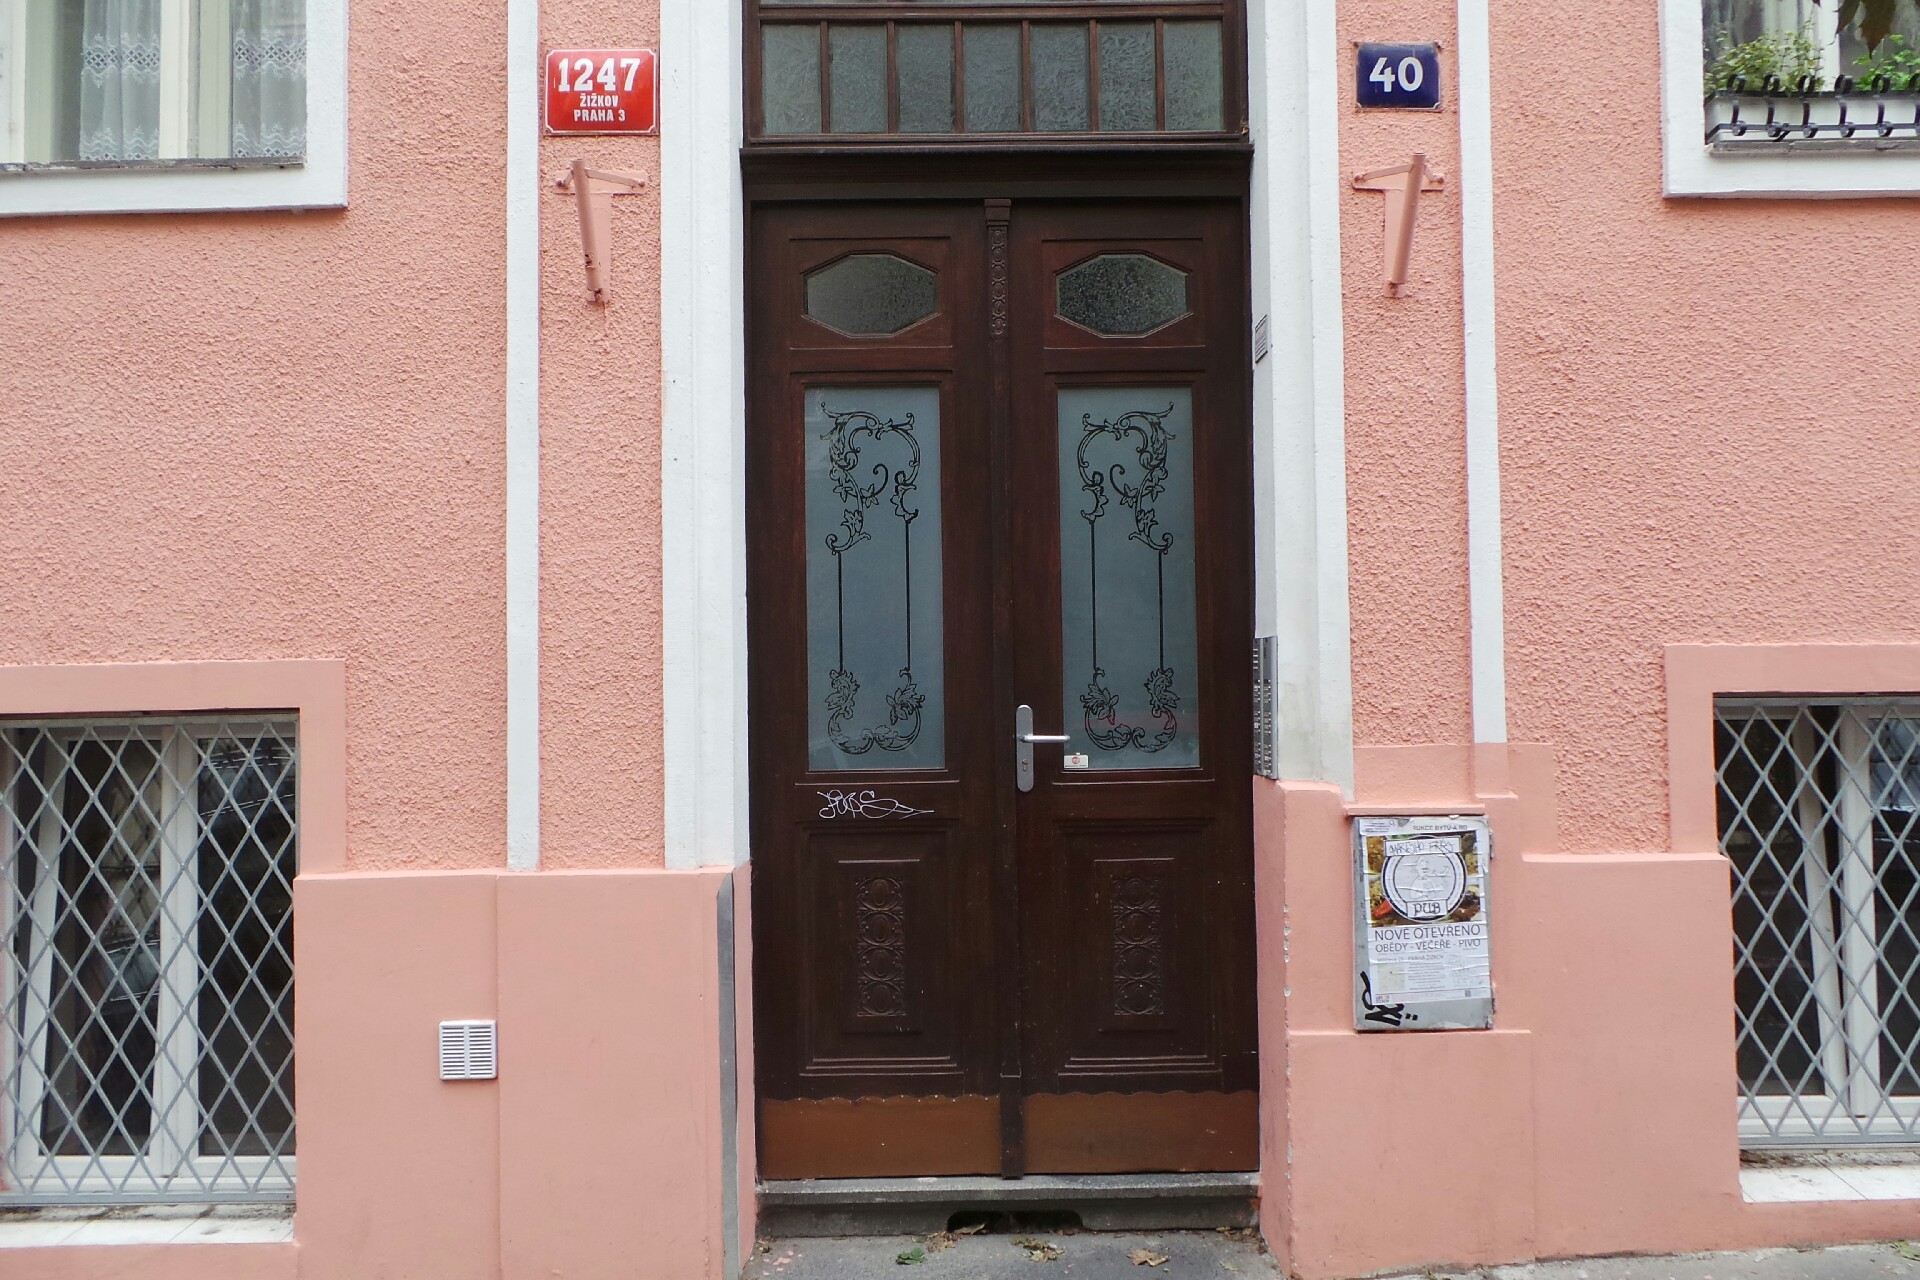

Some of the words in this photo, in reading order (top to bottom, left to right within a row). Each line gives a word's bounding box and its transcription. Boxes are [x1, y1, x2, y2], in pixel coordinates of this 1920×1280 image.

[558, 58, 640, 91] 1247
[1369, 56, 1424, 93] 40
[580, 93, 618, 107] ŽIŽKOV
[574, 109, 614, 121] PRAHA
[618, 109, 626, 121] 3
[1413, 902, 1441, 915] PUB
[1458, 938, 1481, 948] PIVO
